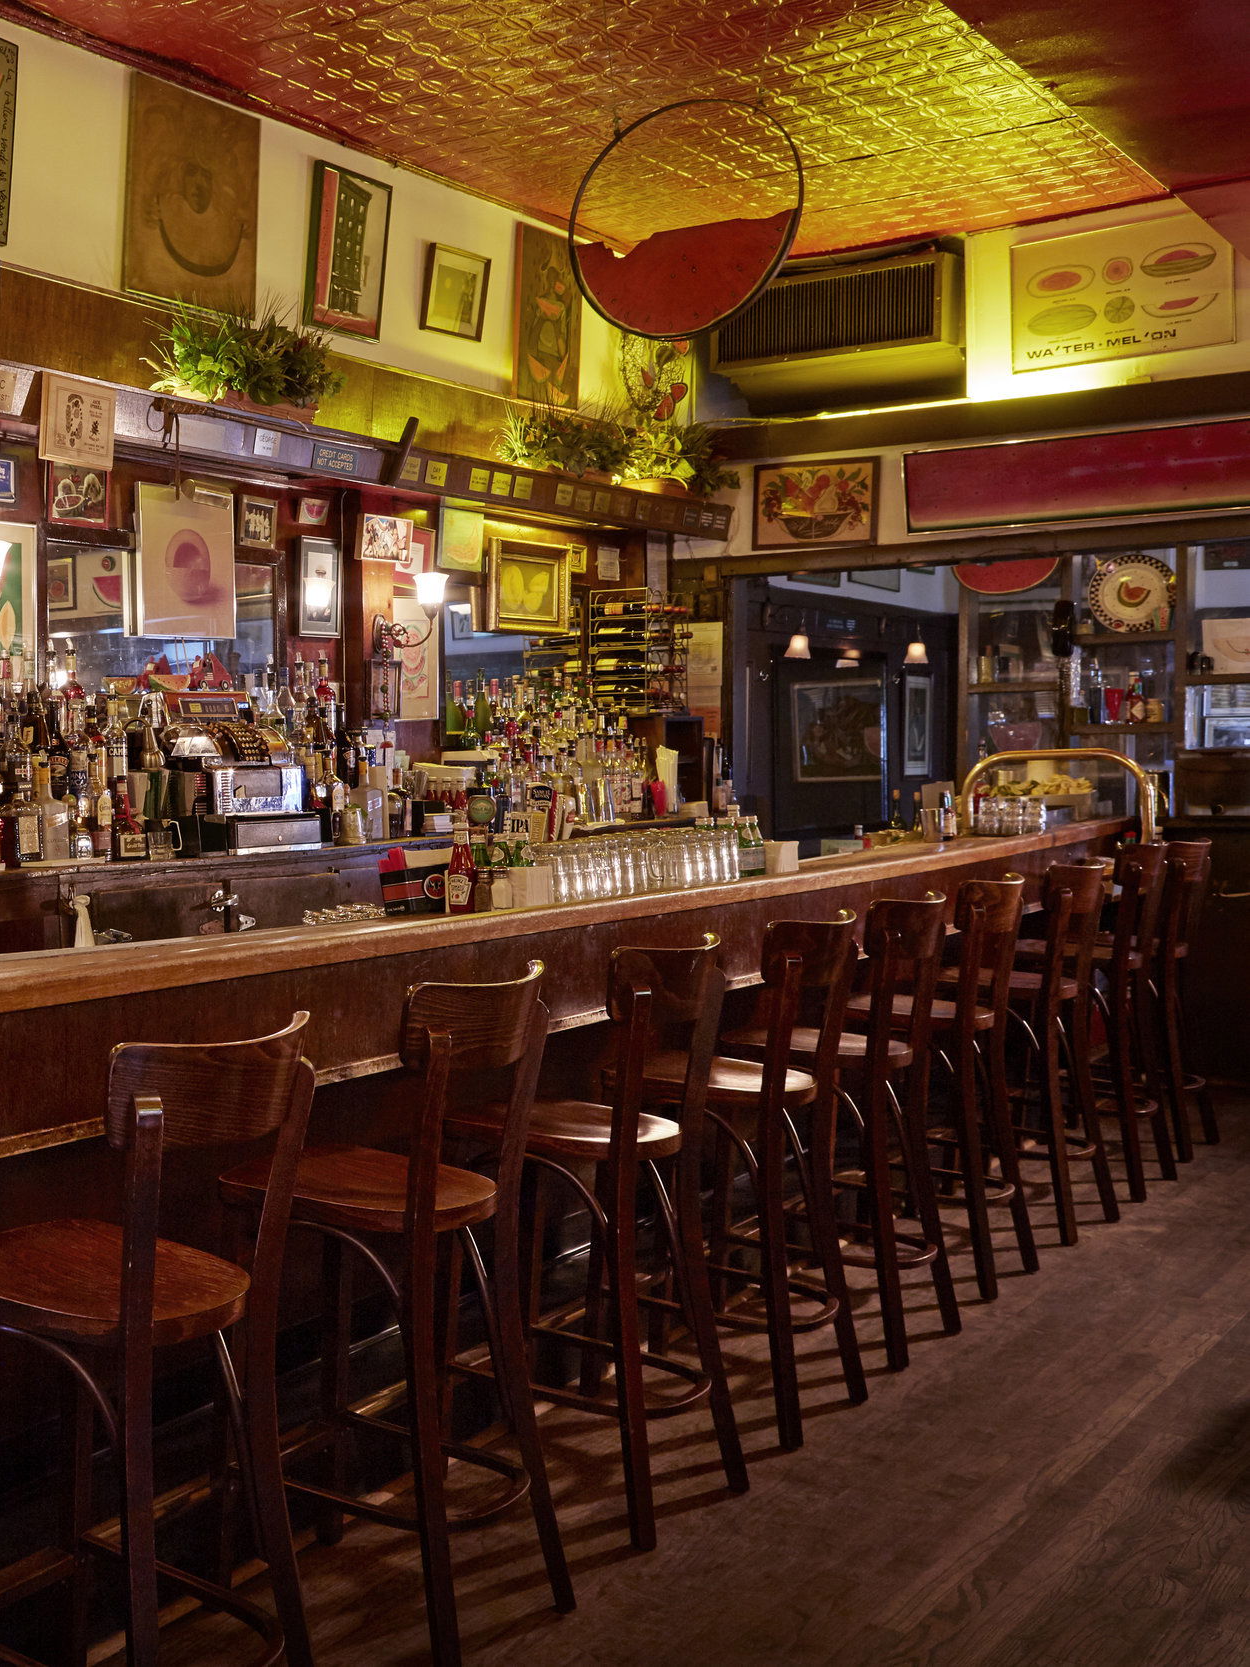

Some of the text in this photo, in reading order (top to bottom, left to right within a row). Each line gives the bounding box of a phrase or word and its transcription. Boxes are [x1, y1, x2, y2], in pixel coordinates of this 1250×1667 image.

[318, 448, 354, 462] CREDIT CARDS
[316, 457, 354, 471] NOT ACCEPTED
